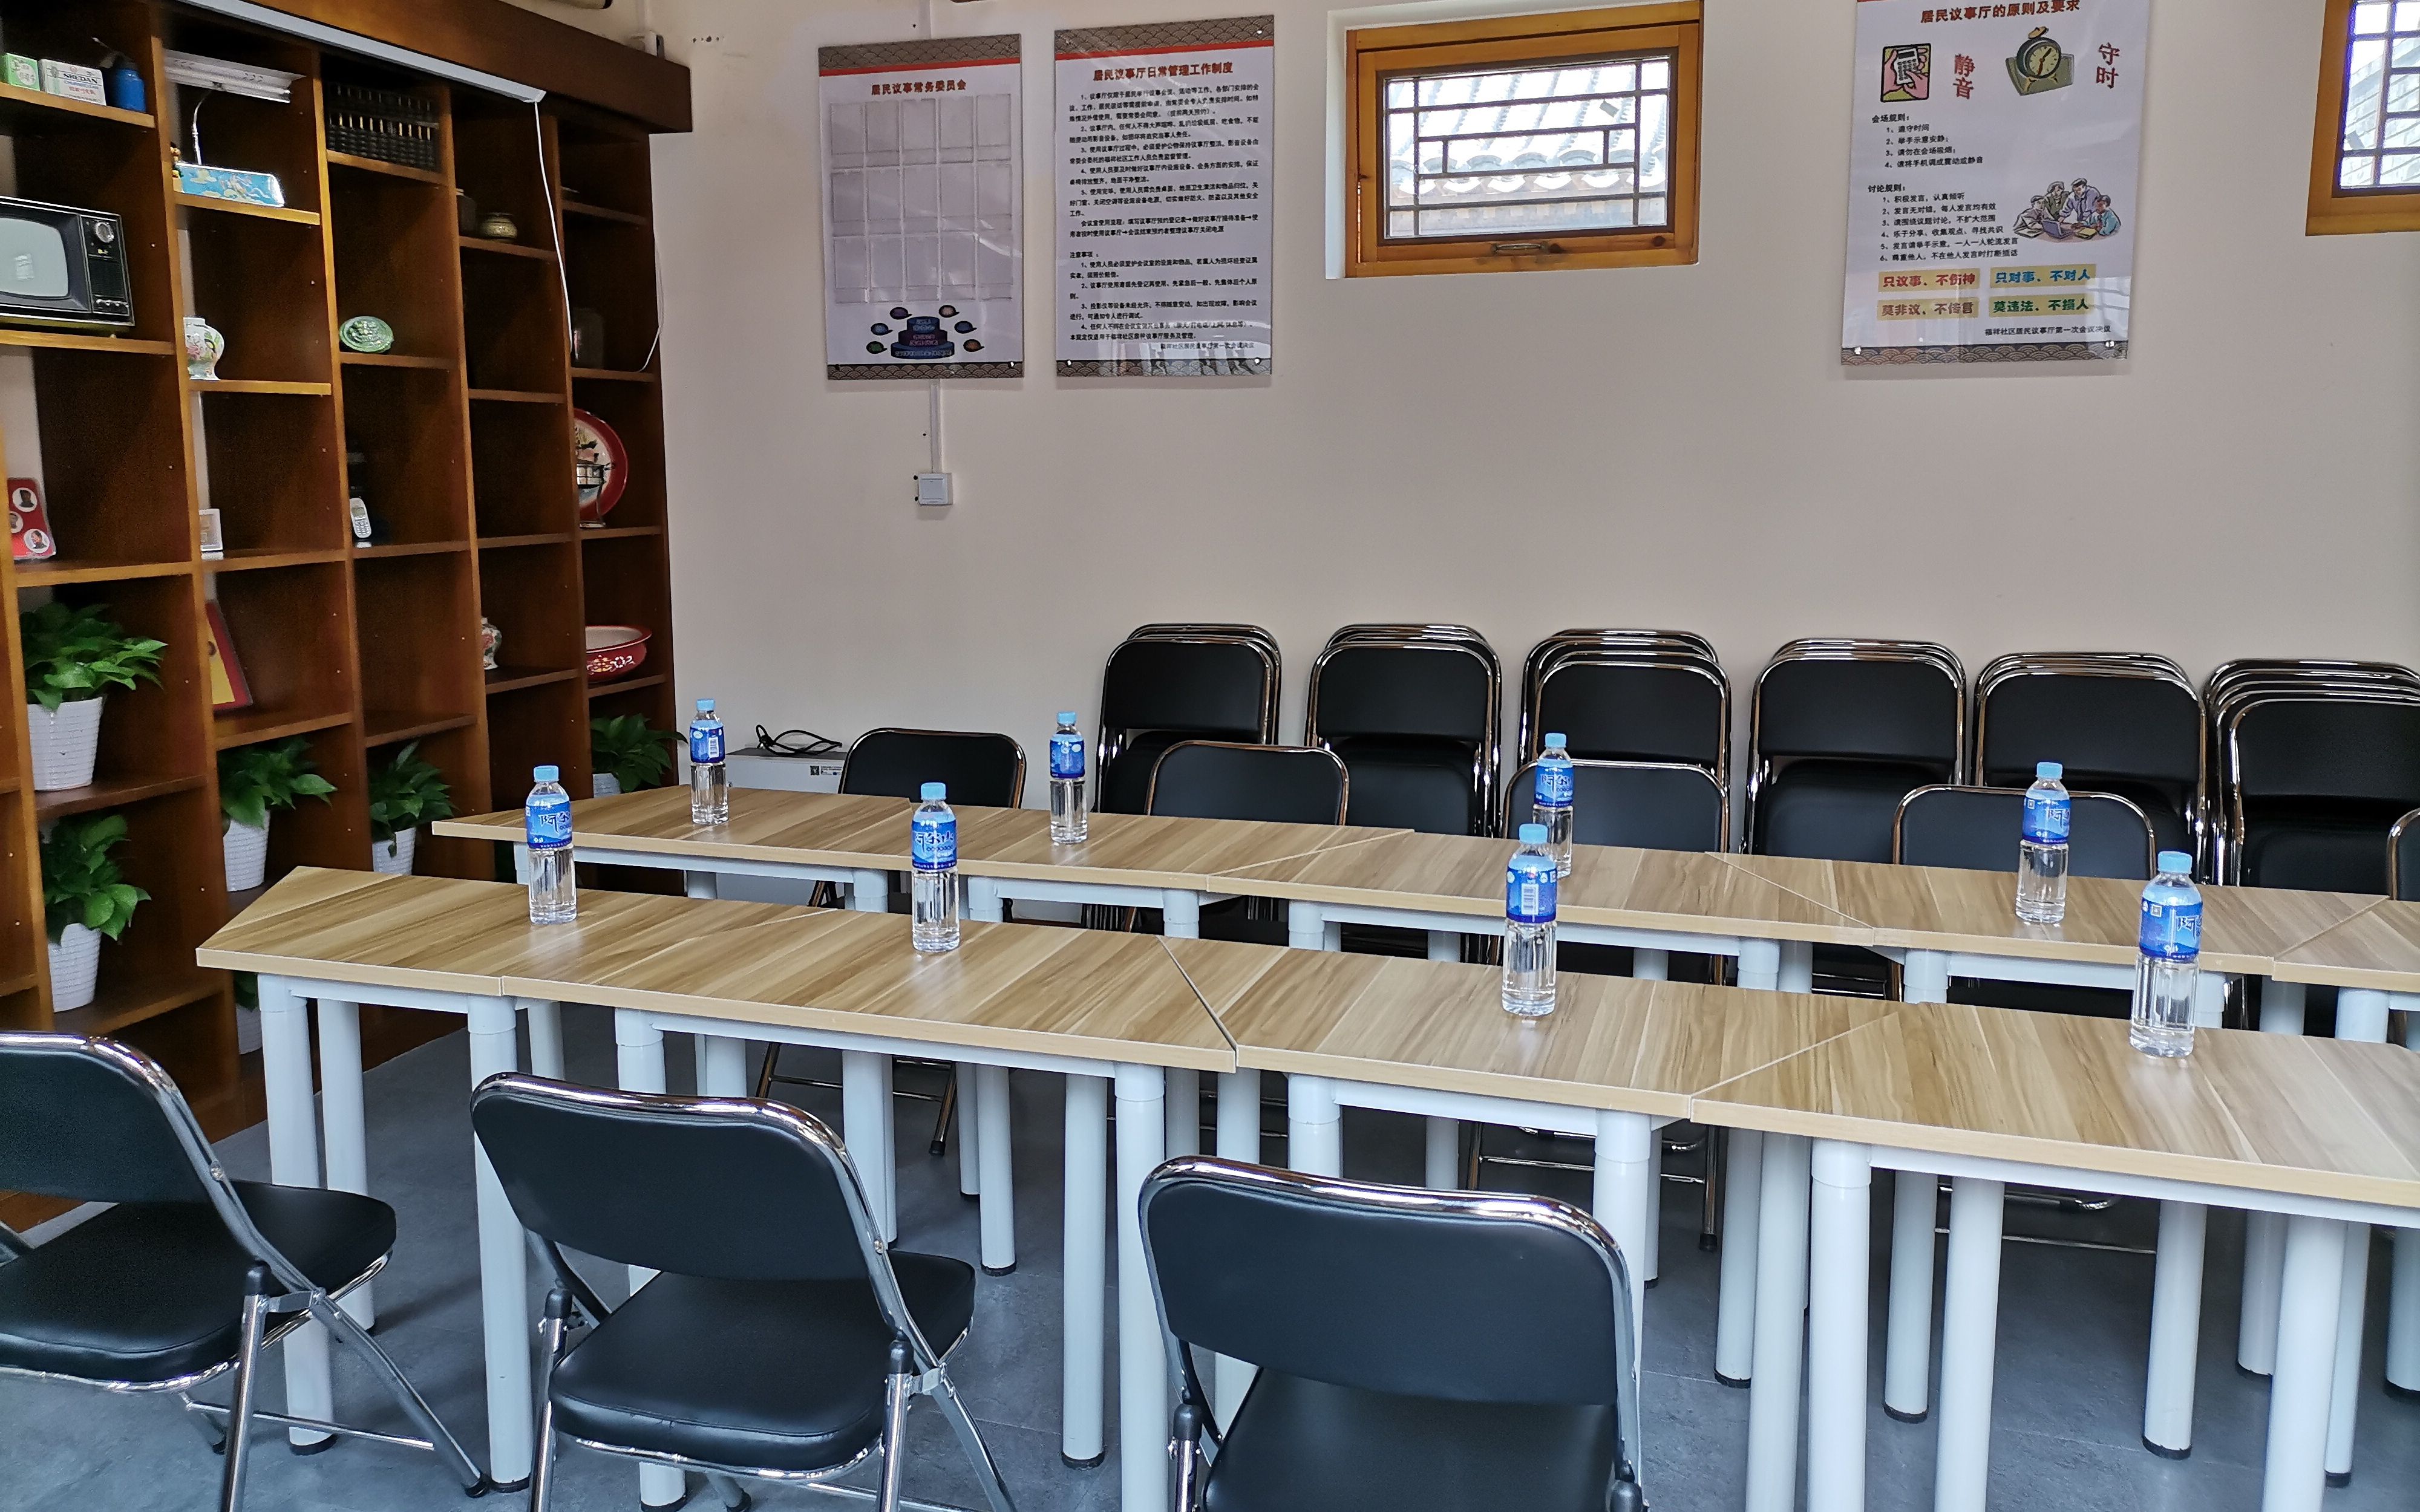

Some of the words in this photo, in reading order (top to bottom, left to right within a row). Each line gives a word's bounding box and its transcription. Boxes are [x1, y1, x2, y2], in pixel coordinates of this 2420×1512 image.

[1920, 0, 2080, 23] 居民议事厅的原则及要求
[1093, 62, 1233, 81] 居民议事厅日常管理工作制度
[2096, 42, 2120, 89] 守时
[1953, 54, 1975, 99] 静音
[871, 79, 966, 95] 居民议事常务委员会
[1872, 113, 1909, 123] 会场规则：
[1868, 183, 1905, 193] 讨论规则：
[1995, 269, 2091, 284] 只对事、不对人
